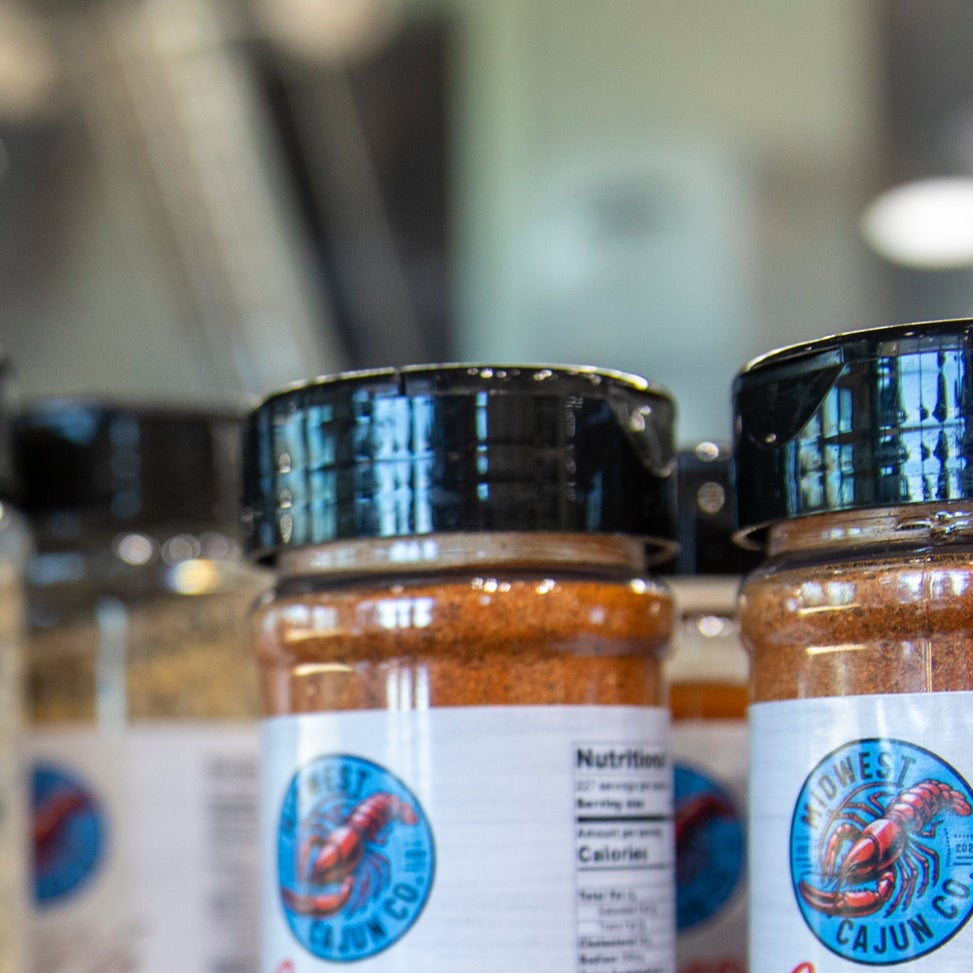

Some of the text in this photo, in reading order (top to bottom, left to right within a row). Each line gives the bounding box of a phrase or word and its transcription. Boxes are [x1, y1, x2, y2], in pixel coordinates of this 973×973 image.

[803, 751, 917, 830] MIDWEST
[579, 846, 649, 862] Calories
[308, 876, 426, 954] CAJUN CO.
[835, 914, 935, 954] CAJUN
